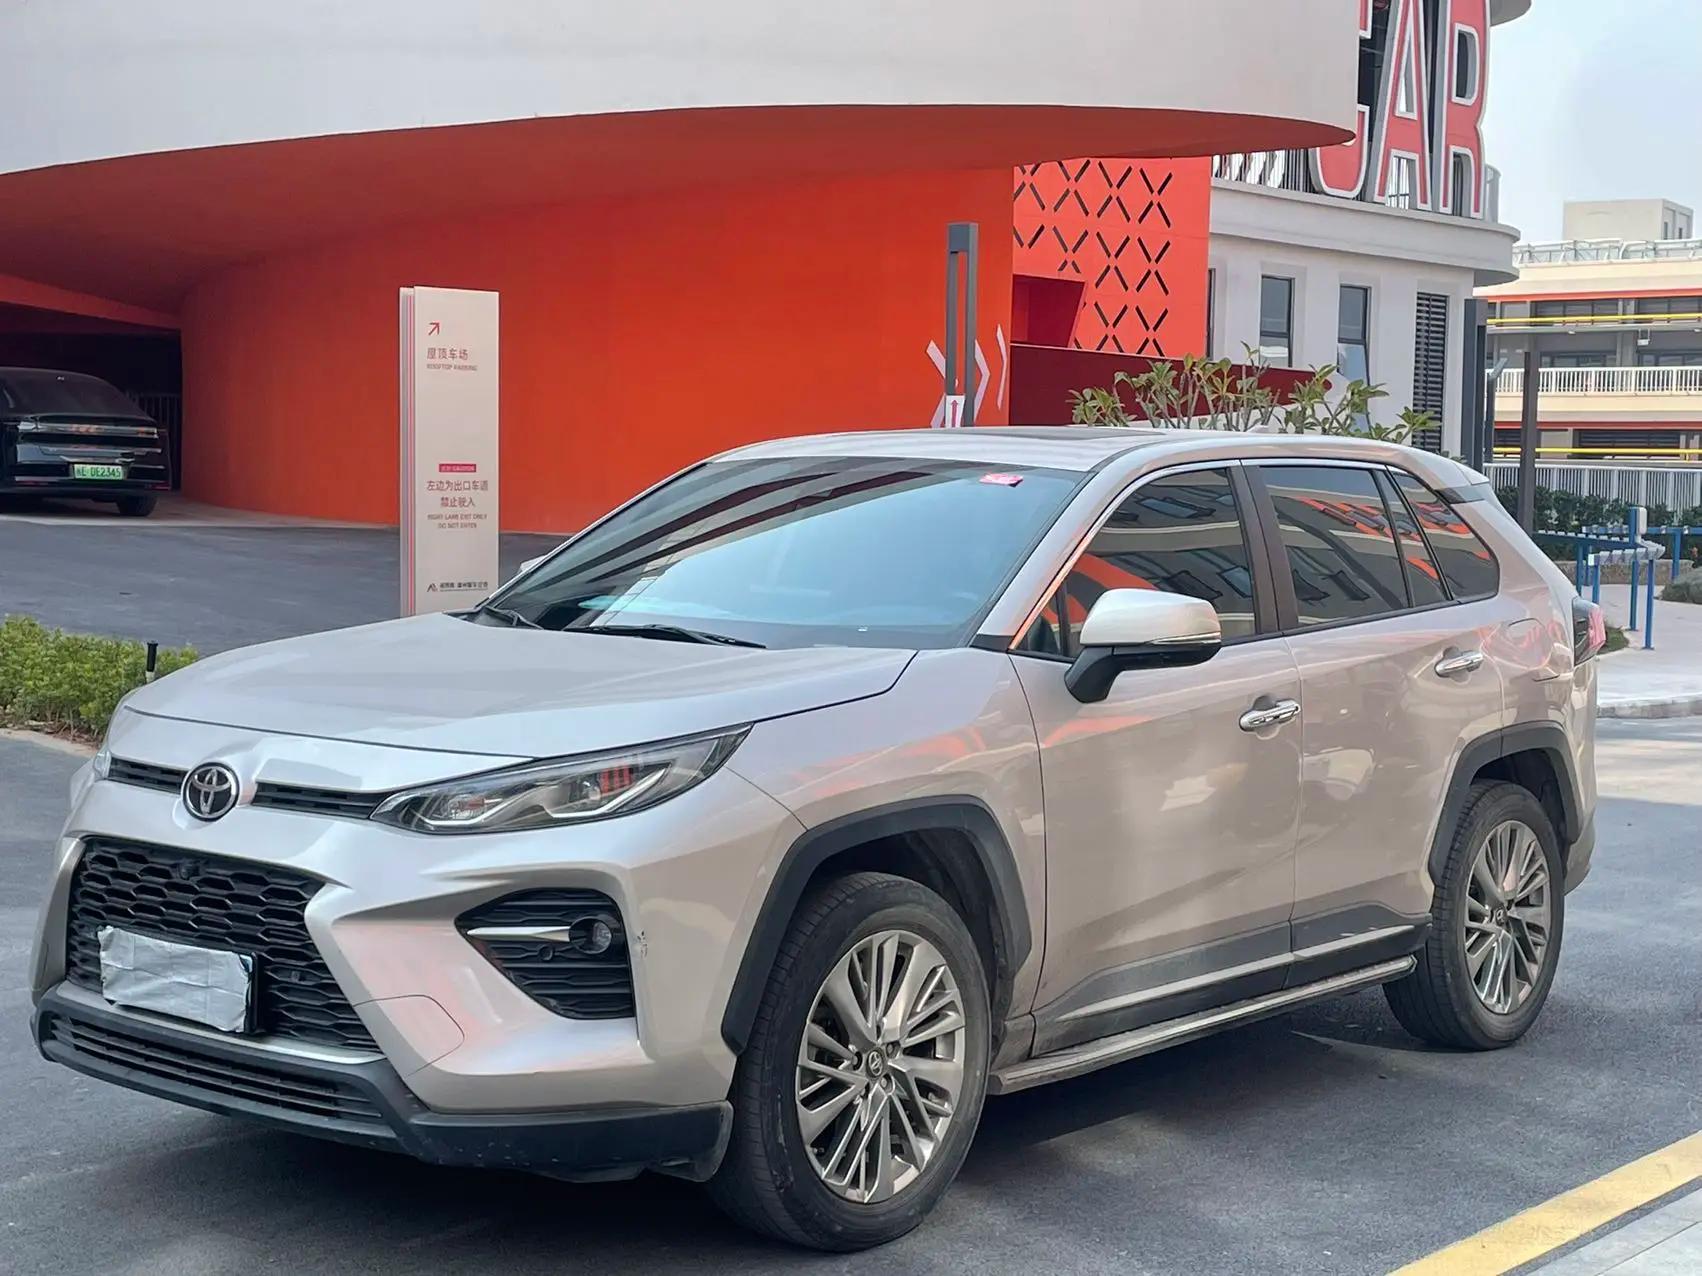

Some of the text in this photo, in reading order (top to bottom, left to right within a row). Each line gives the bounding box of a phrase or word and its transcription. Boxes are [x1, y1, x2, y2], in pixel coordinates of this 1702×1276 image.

[427, 347, 469, 360] 屋顶车场
[427, 480, 488, 492] 左边为出口车道
[440, 497, 475, 508] 禁止驶入
